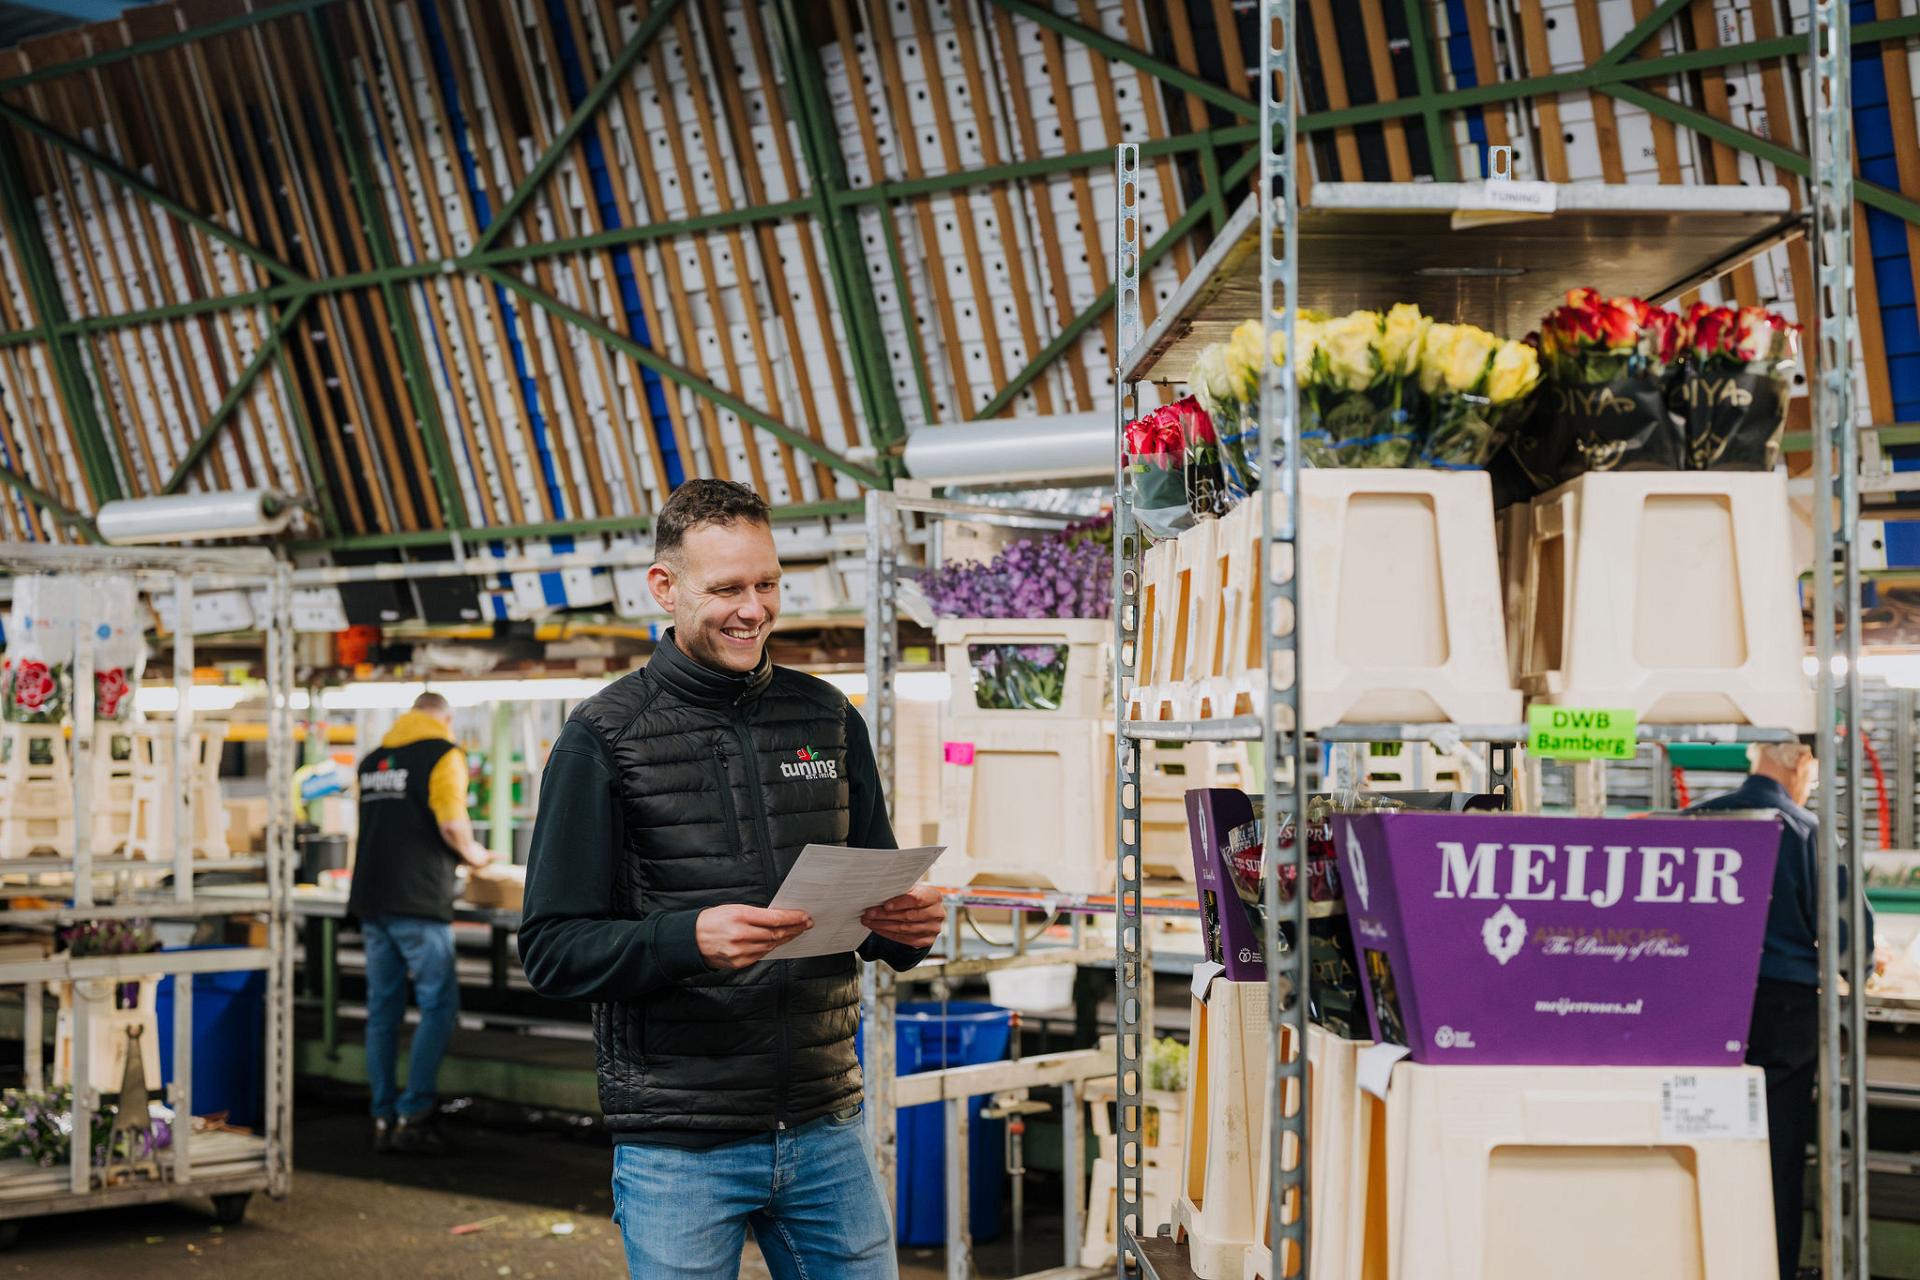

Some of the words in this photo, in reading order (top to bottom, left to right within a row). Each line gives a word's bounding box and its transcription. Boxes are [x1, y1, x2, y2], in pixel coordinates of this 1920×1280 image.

[1489, 191, 1542, 204] TUNING
[1552, 711, 1610, 728] DWB
[1538, 732, 1625, 755] Bamberg
[779, 759, 838, 779] tuning
[1433, 841, 1745, 909] MEIJER
